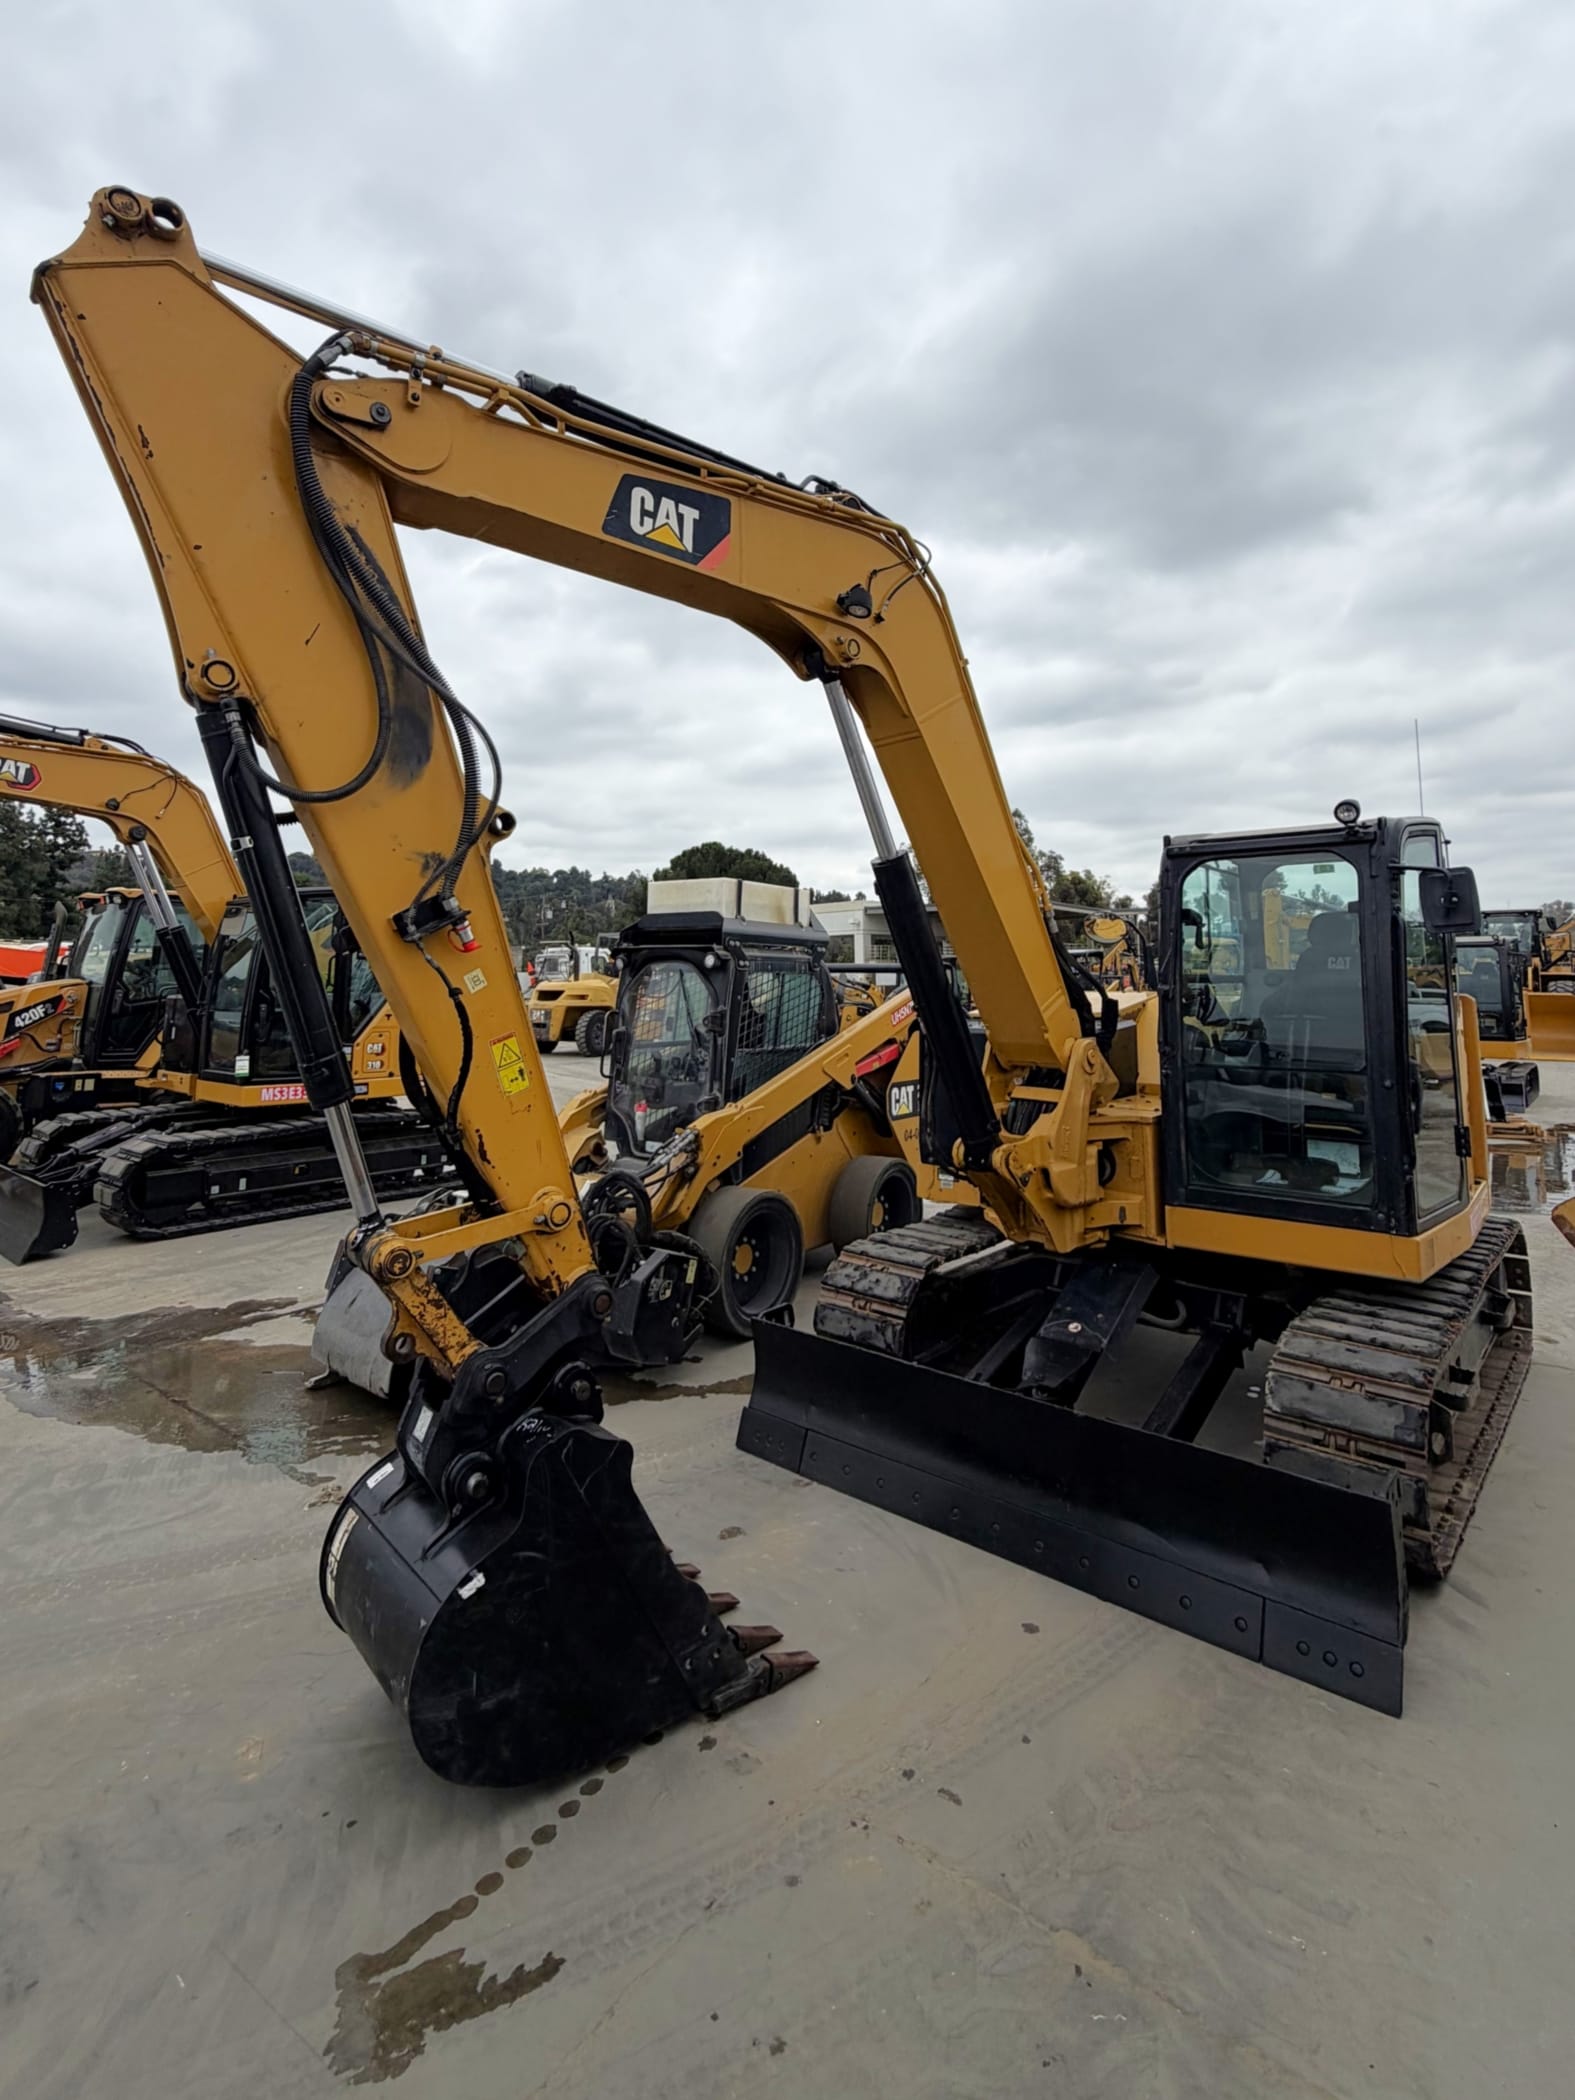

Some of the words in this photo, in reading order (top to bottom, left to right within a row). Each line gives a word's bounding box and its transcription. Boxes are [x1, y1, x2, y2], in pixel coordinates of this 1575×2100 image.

[630, 486, 699, 553] CAT
[0, 758, 31, 784] AT
[1327, 957, 1351, 969] CAT
[14, 1003, 54, 1028] 420F2
[367, 1043, 382, 1054] CAT
[891, 1085, 914, 1116] CAT
